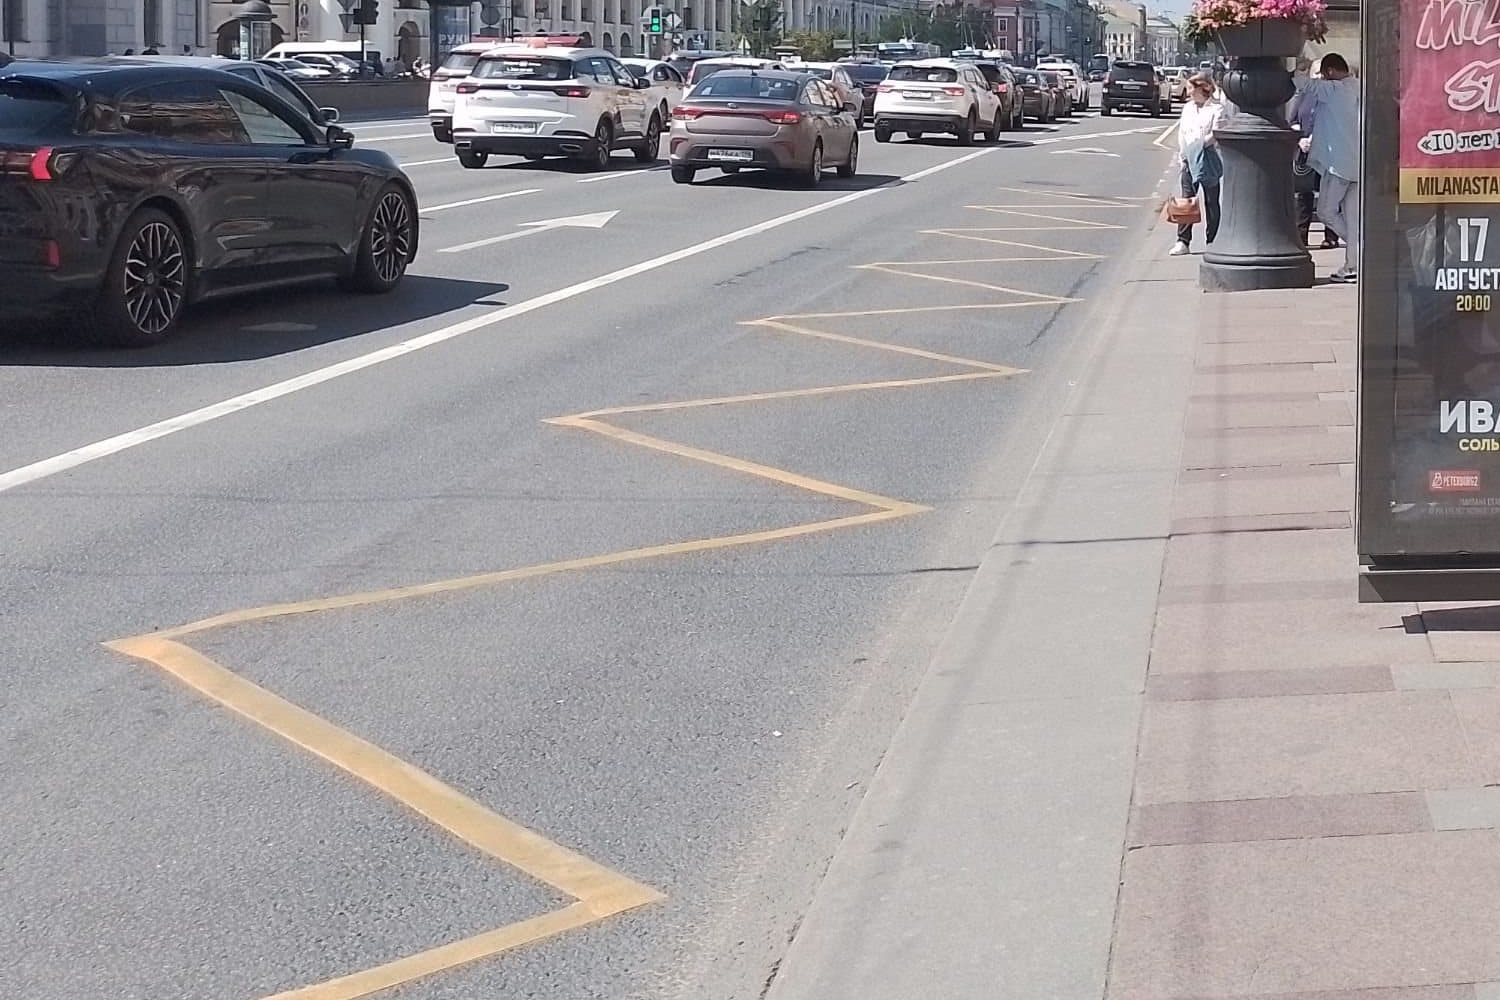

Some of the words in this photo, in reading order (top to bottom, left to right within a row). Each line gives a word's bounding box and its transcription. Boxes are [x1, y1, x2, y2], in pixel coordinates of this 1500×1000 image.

[1460, 132, 1491, 147] лет
[1457, 218, 1489, 261] 17
[1456, 295, 1490, 311] 20:00
